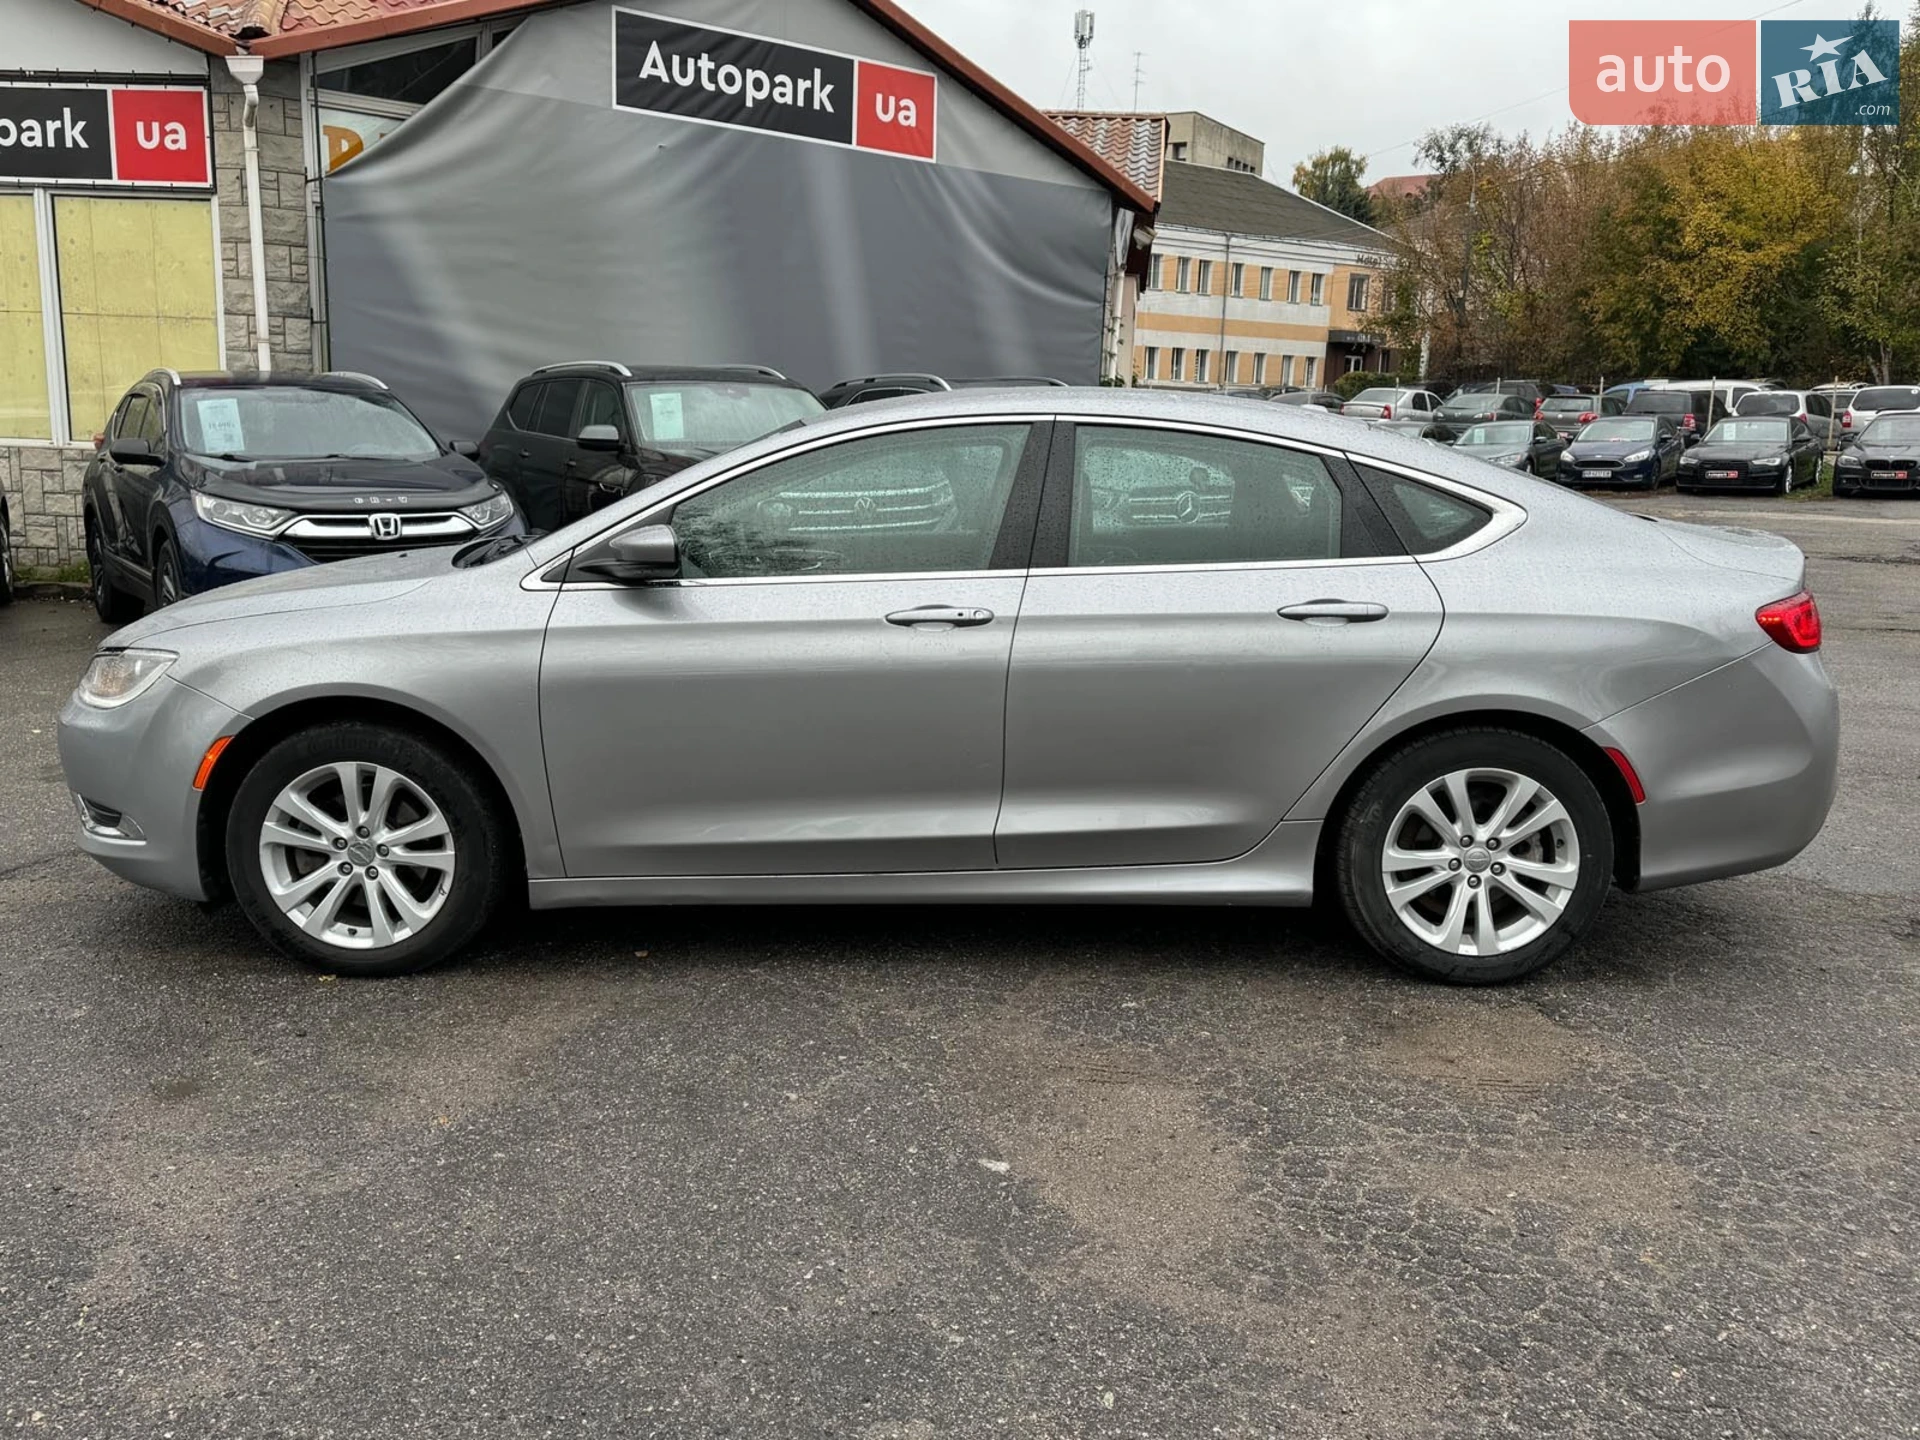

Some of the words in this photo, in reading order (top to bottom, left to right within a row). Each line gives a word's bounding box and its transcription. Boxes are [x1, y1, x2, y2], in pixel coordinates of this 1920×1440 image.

[638, 40, 835, 113] Autopark
[875, 92, 917, 128] ua
[136, 120, 188, 151] ua
